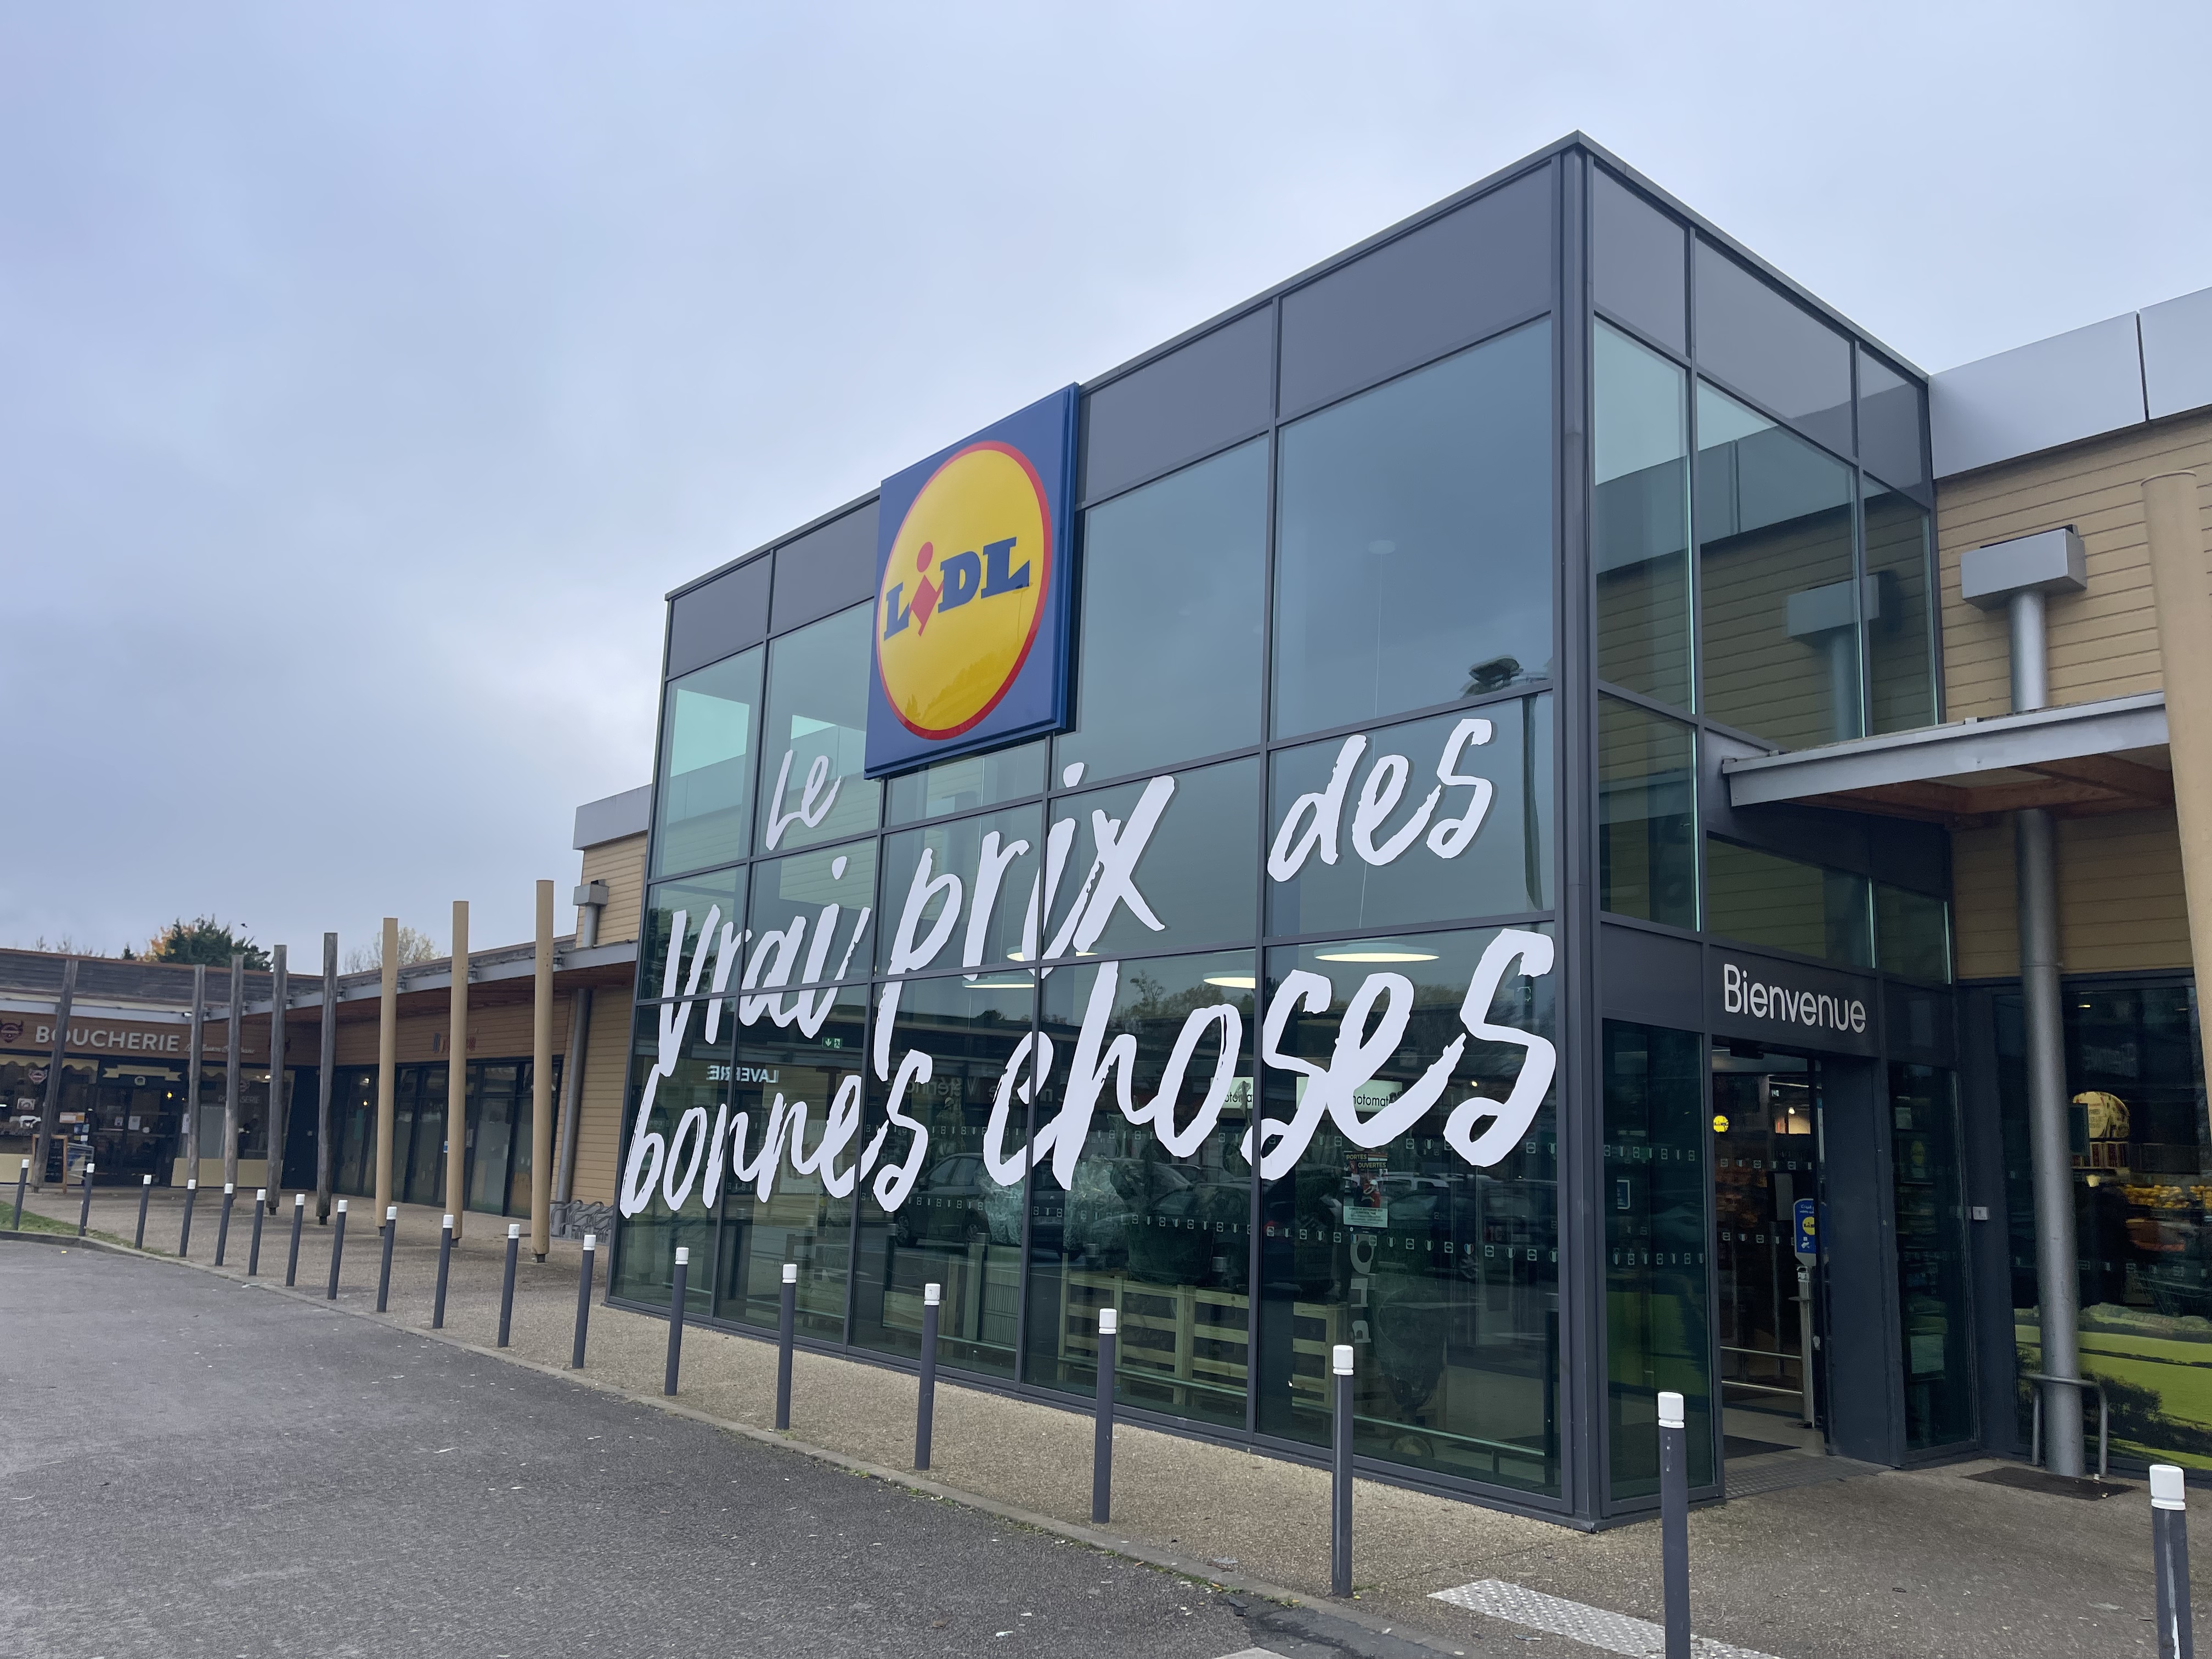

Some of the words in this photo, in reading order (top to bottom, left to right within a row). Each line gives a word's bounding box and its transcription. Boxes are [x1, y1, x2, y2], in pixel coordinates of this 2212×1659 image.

[766, 750, 842, 850] Le
[873, 762, 1175, 1082] prix
[1267, 718, 1493, 882] des
[619, 1049, 933, 1219] bonnes
[983, 928, 1556, 1191] choses
[1724, 963, 1866, 1033] Bienvenue
